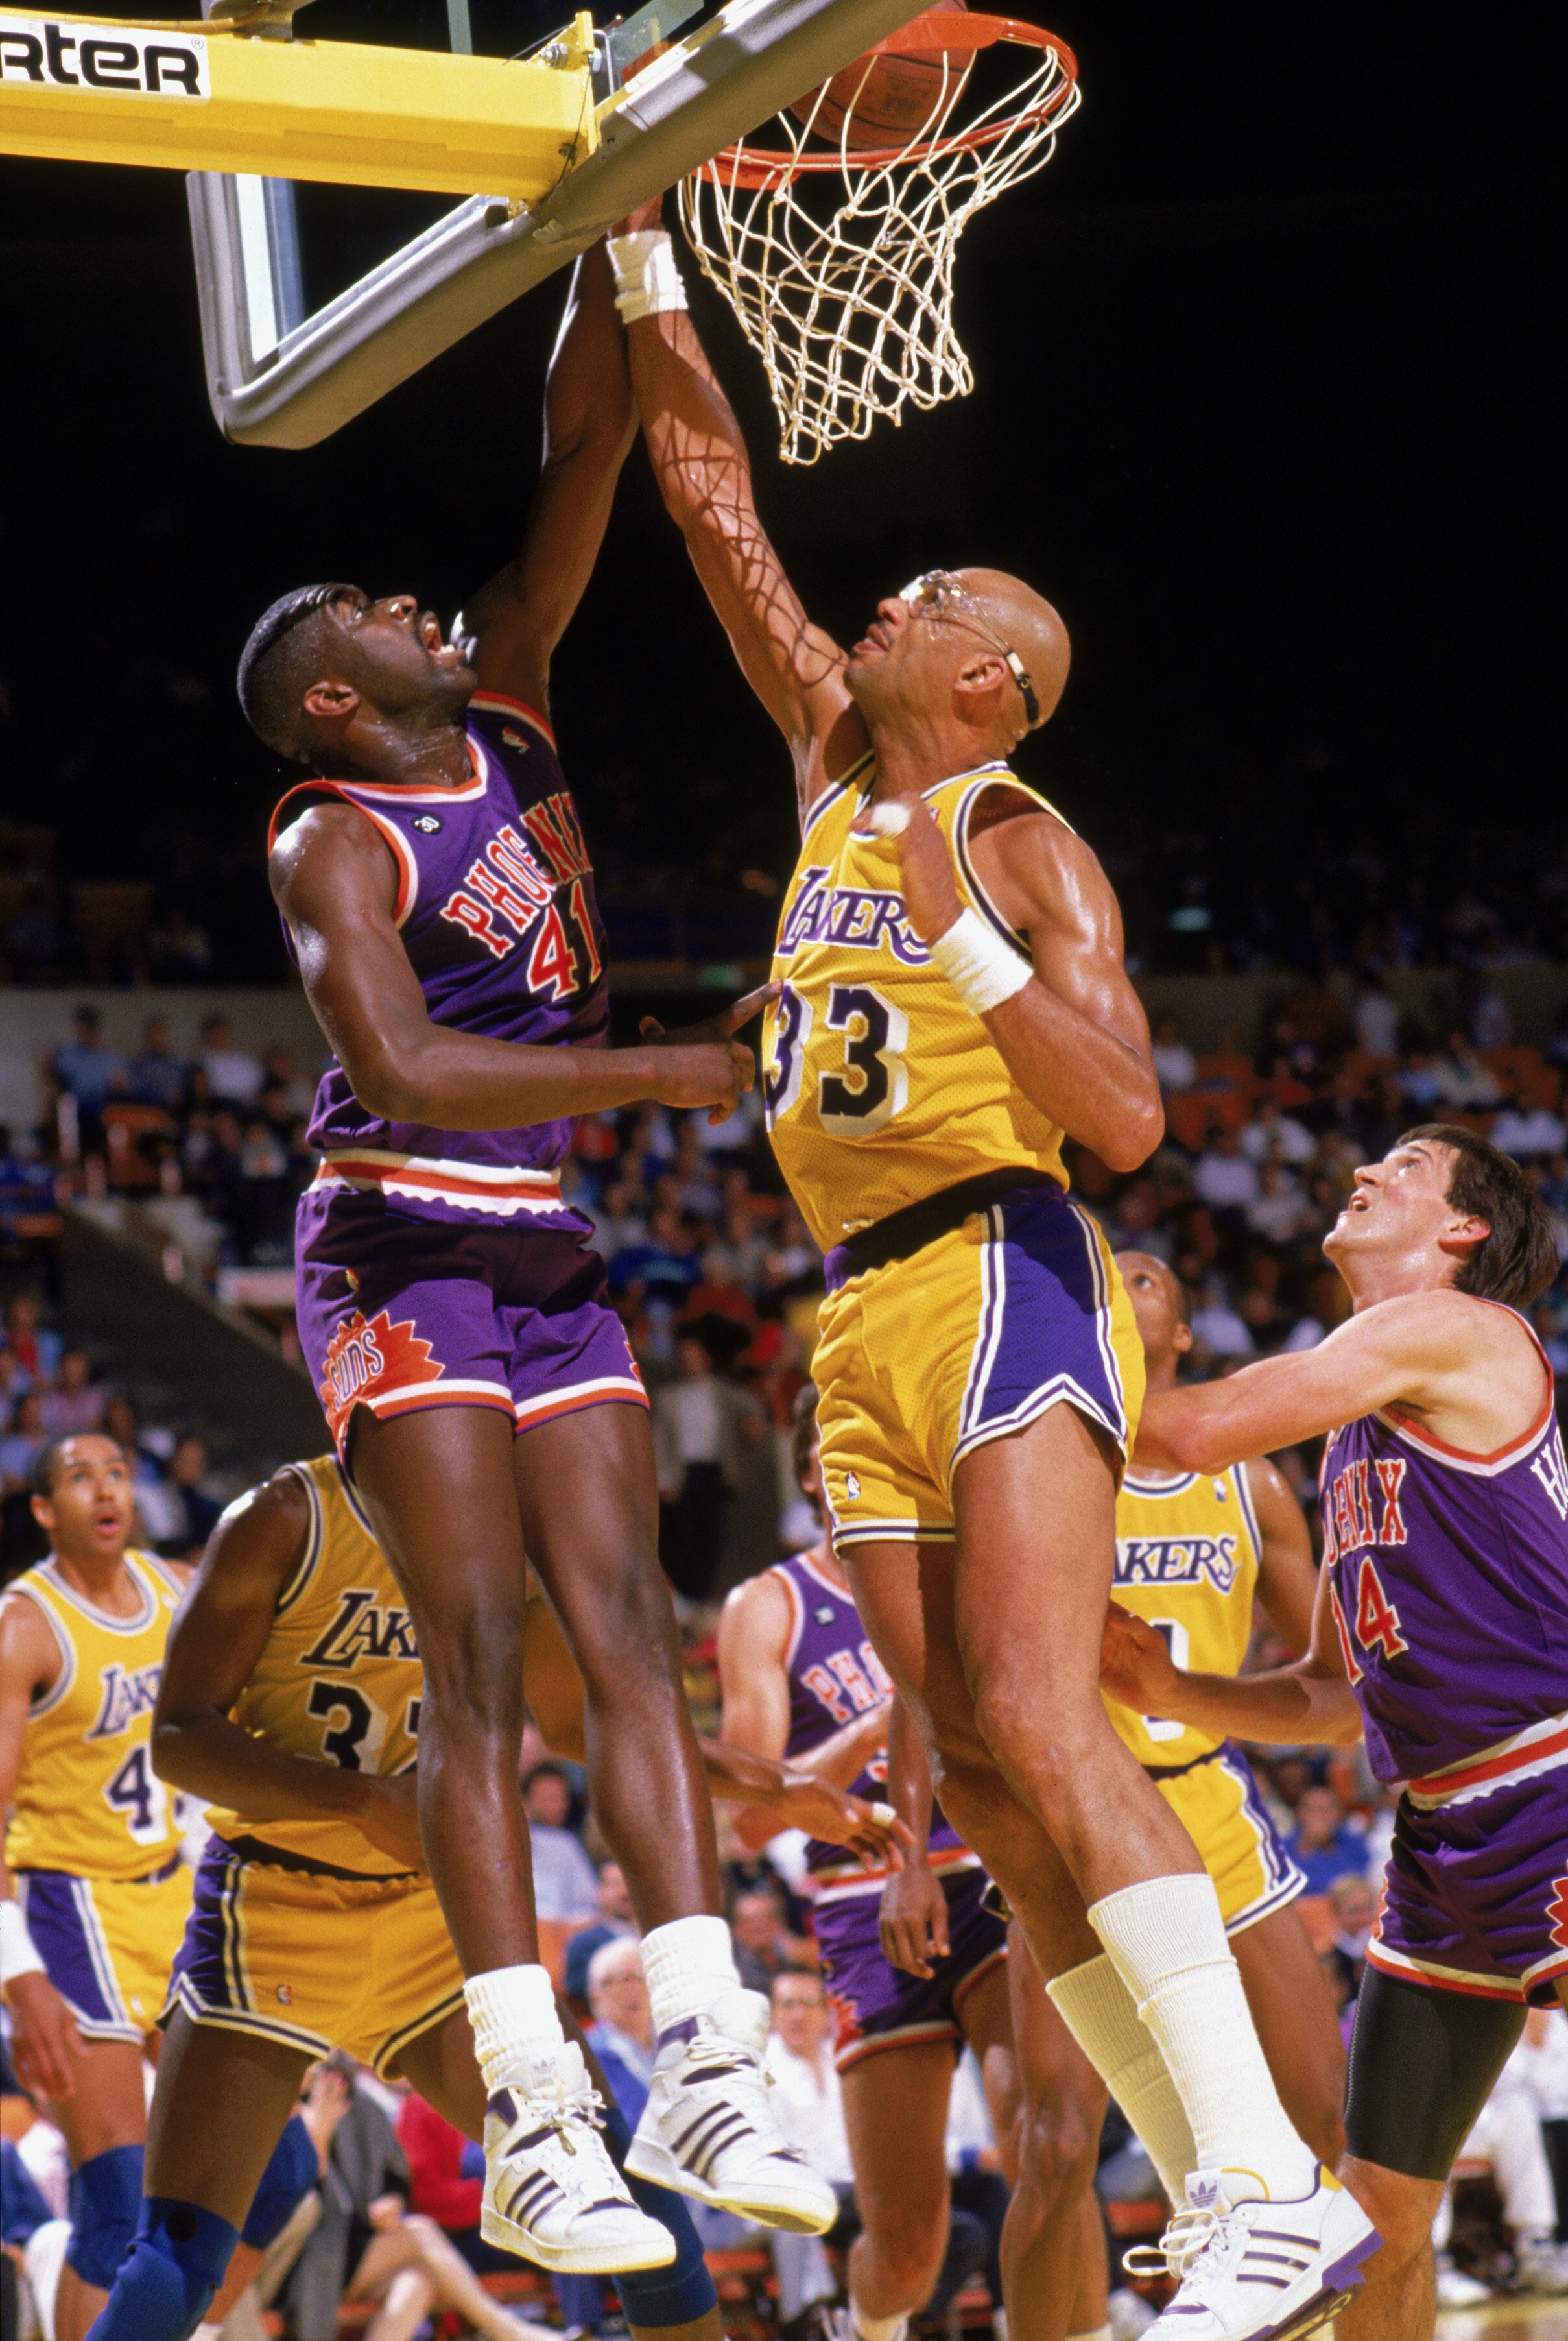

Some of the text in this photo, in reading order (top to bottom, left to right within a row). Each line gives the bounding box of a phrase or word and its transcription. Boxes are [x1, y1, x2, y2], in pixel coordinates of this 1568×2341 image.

[527, 878, 602, 1002] 41
[765, 979, 908, 1136] 33
[1330, 1556, 1409, 1687] 14
